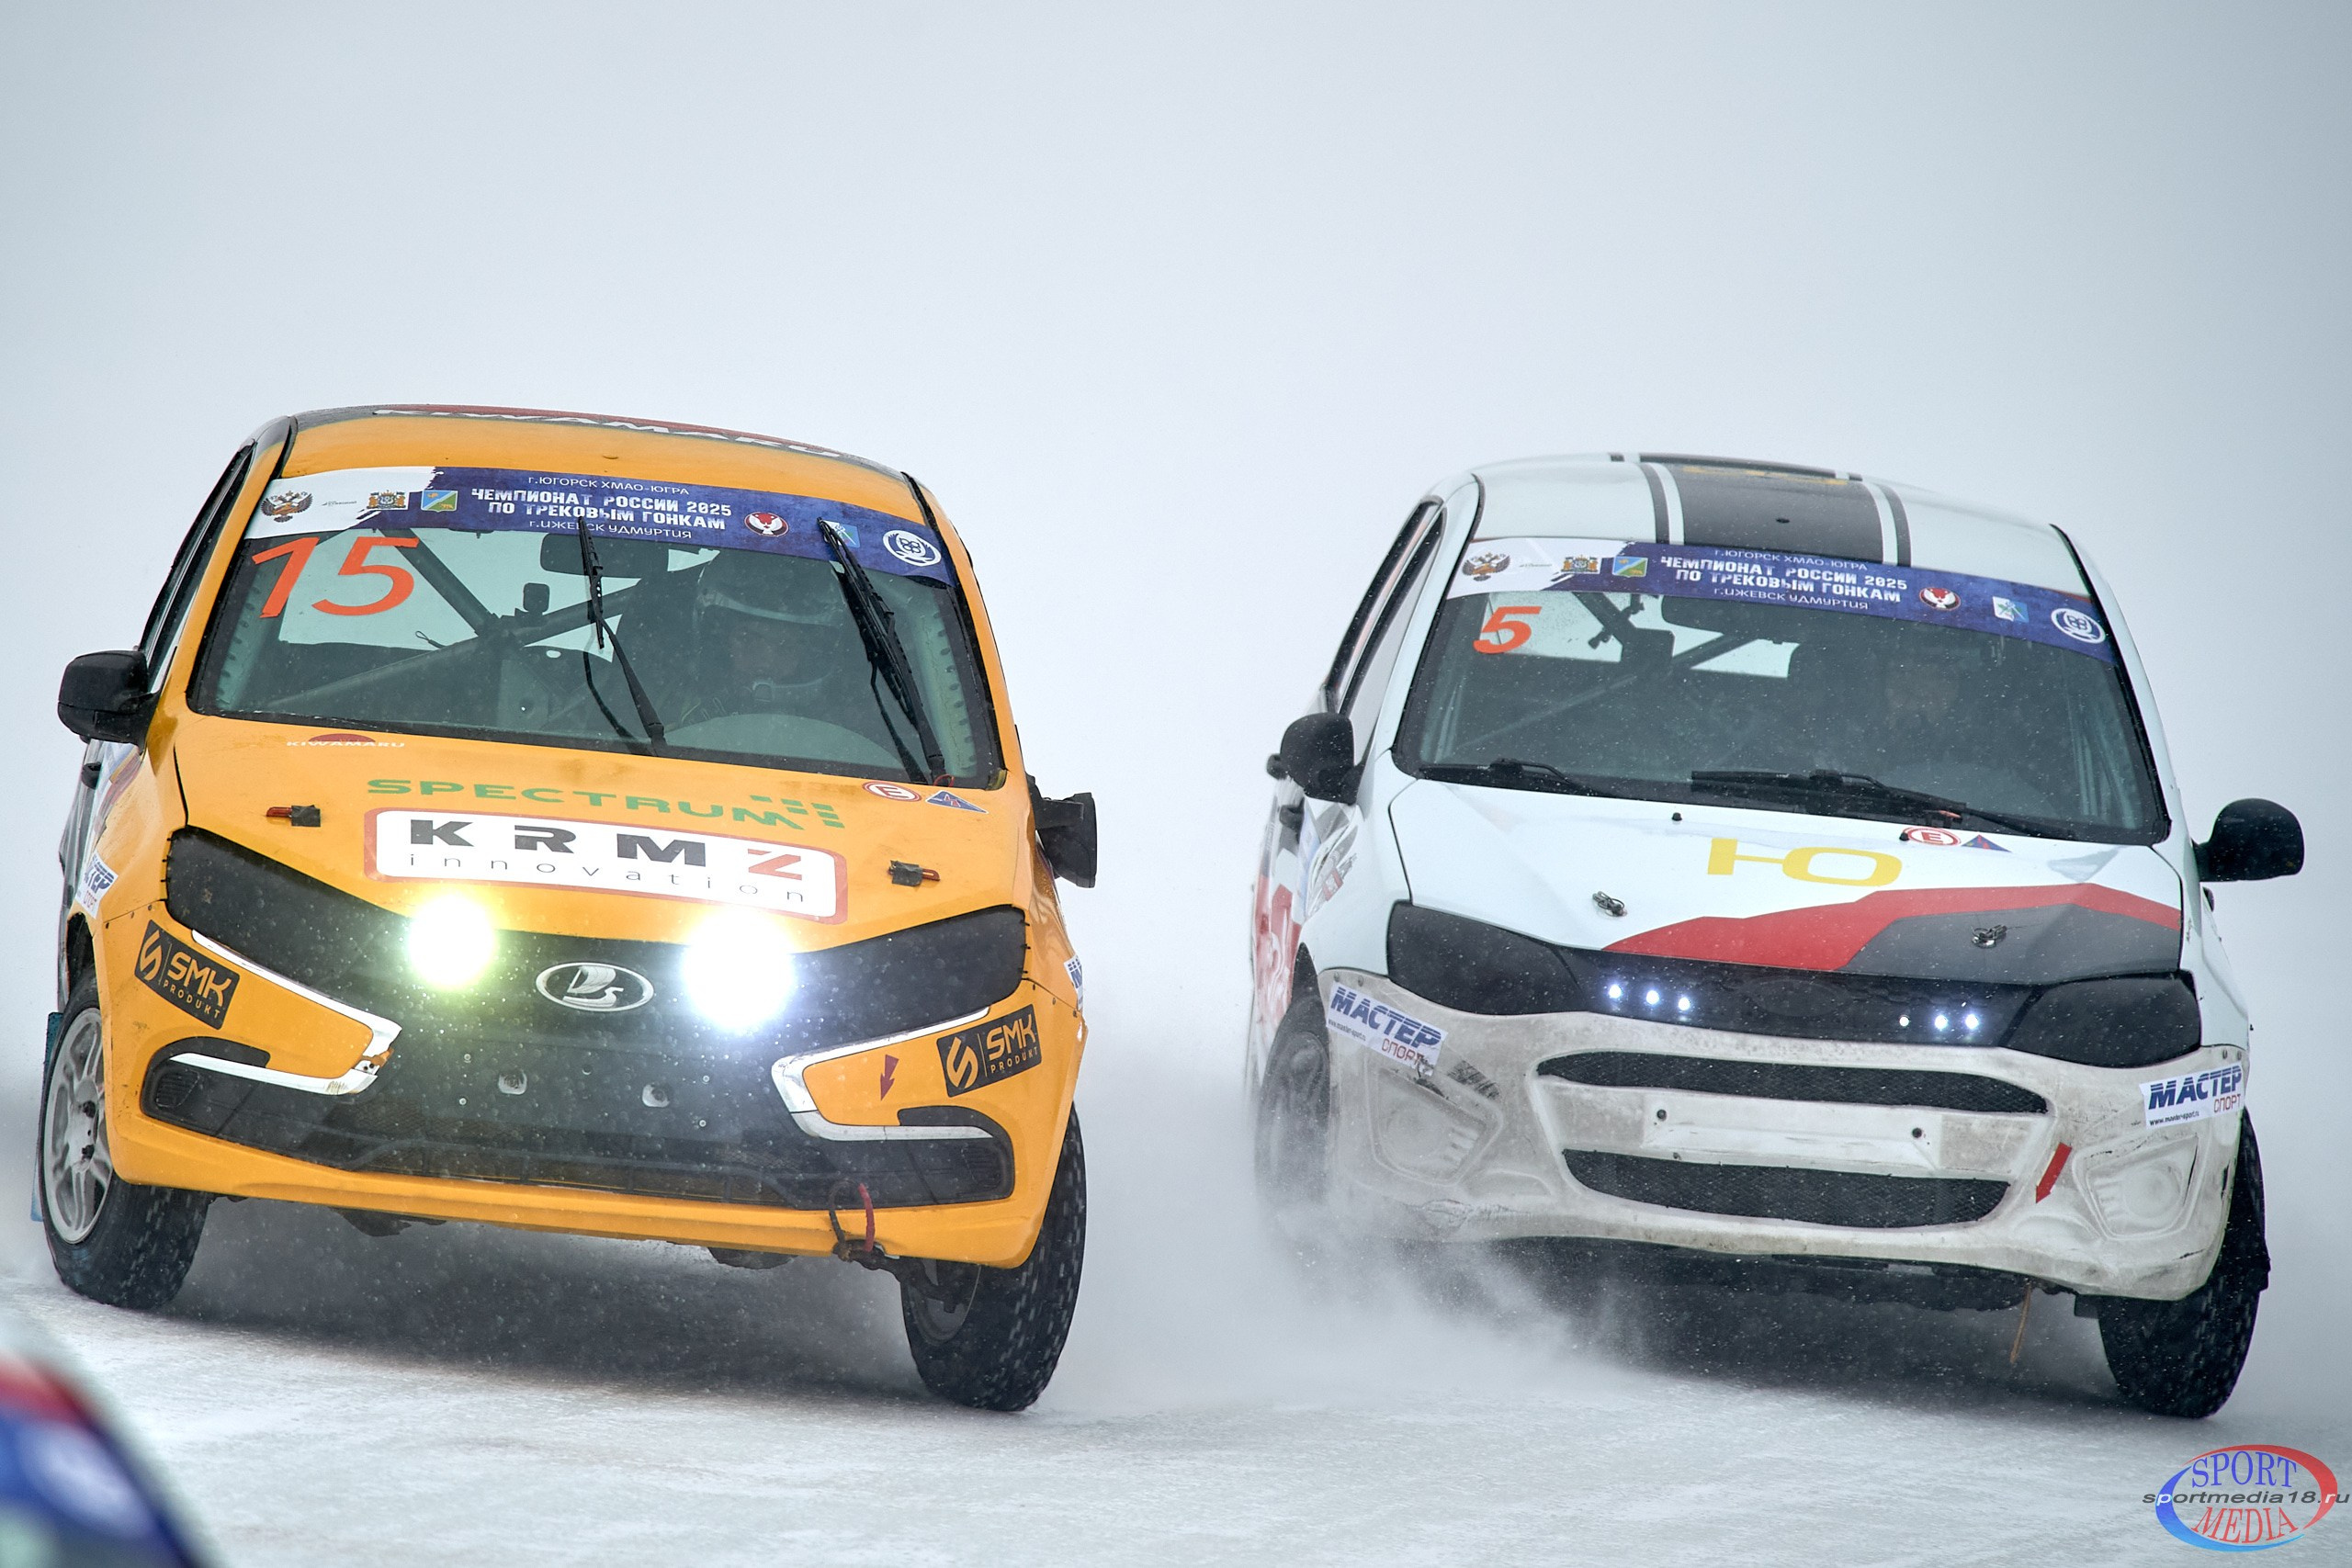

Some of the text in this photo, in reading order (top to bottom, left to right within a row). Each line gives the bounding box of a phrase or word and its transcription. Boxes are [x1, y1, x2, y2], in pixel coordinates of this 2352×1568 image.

[471, 489, 732, 516] ЧЕМПИОНАТ РОССИИ 2025
[528, 477, 690, 496] г.ЮГОРСК ХМАО-ЮГРА
[489, 502, 726, 530] ПО ТРЕКОВЫМ ГОНКАМ
[609, 525, 693, 538] УДМУРТИЯ
[252, 536, 420, 618] 15
[1660, 556, 1908, 590] ЧЕМПИОНАТ РОССИИ 2025
[1783, 556, 1868, 570] ХМАО-ЮГРА
[1675, 570, 1902, 603] ПО ТРЕКОВЫМ ГОНКАМ
[1713, 588, 1869, 610] г.ИЖЕВСК УДМУРТИЯ
[1473, 606, 1542, 654] 5
[368, 779, 805, 830] SPECTRUM
[410, 818, 803, 880] KRMZ
[1707, 838, 1903, 887] Ю
[410, 853, 804, 903] innovation
[163, 979, 221, 1020] PRODUKT
[167, 951, 232, 1007] SMK
[987, 1014, 1035, 1060] SMK
[1330, 986, 1442, 1049] МАСТЕР
[990, 1046, 1037, 1073] PRODUKT
[2148, 1065, 2243, 1111] МАСТЕР
[2213, 1093, 2242, 1113] СПОРТ
